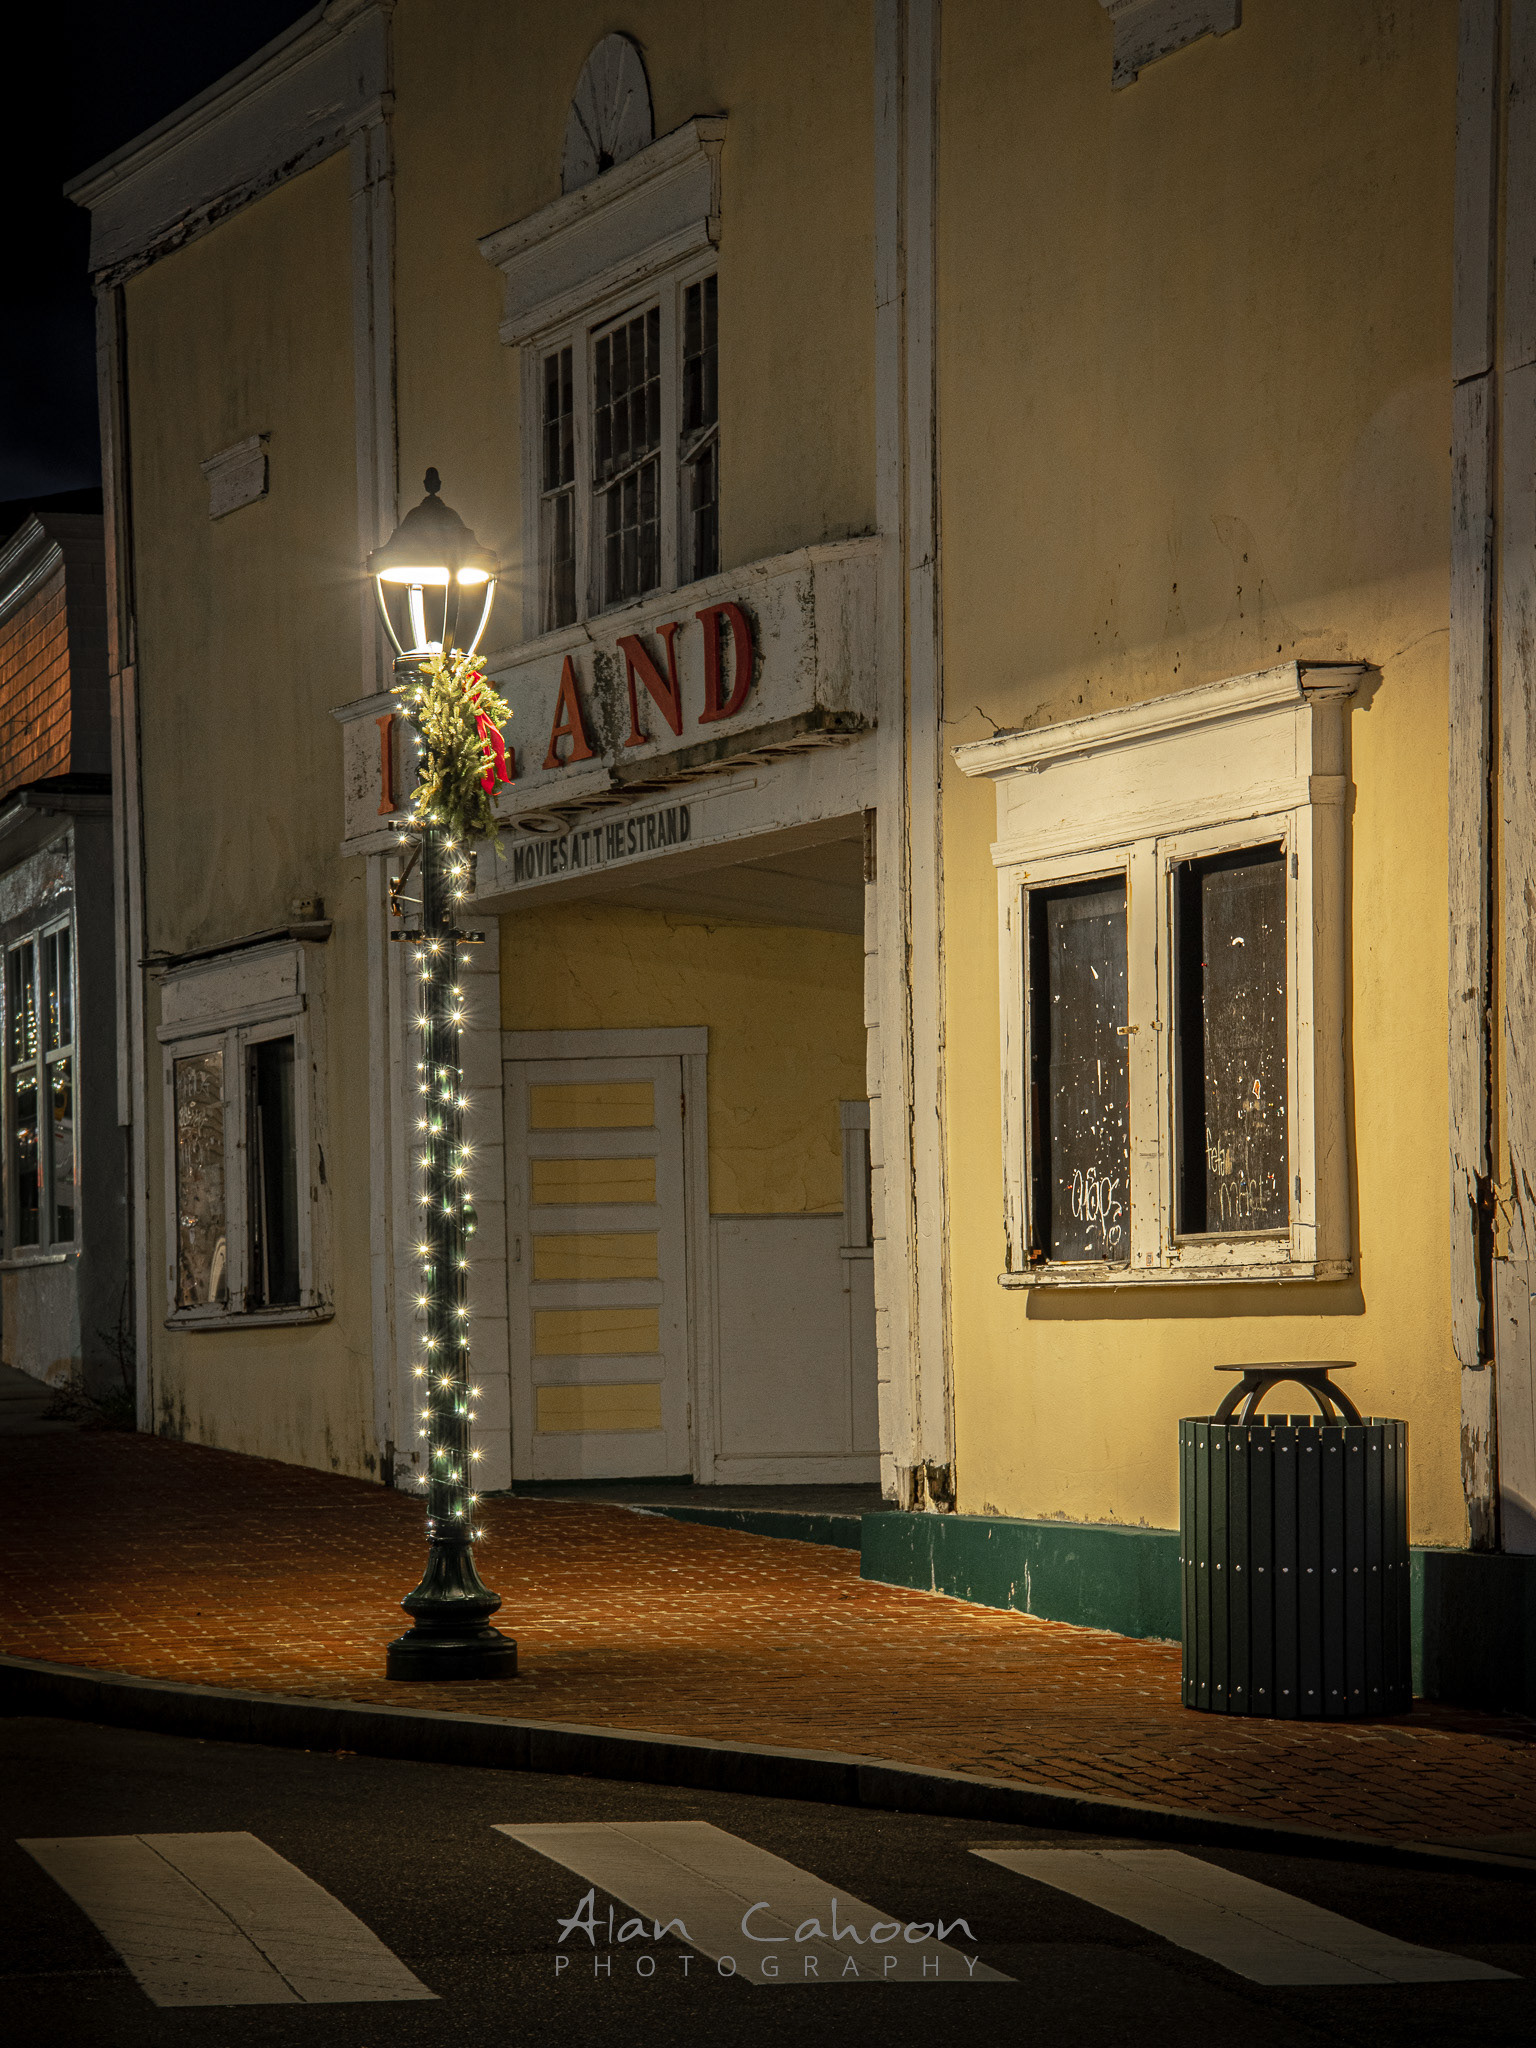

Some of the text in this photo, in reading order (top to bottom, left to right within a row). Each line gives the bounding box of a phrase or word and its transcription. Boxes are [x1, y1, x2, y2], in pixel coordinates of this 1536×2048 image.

[375, 601, 753, 816] IAND
[514, 804, 691, 883] MOVIES AT THE STRAND
